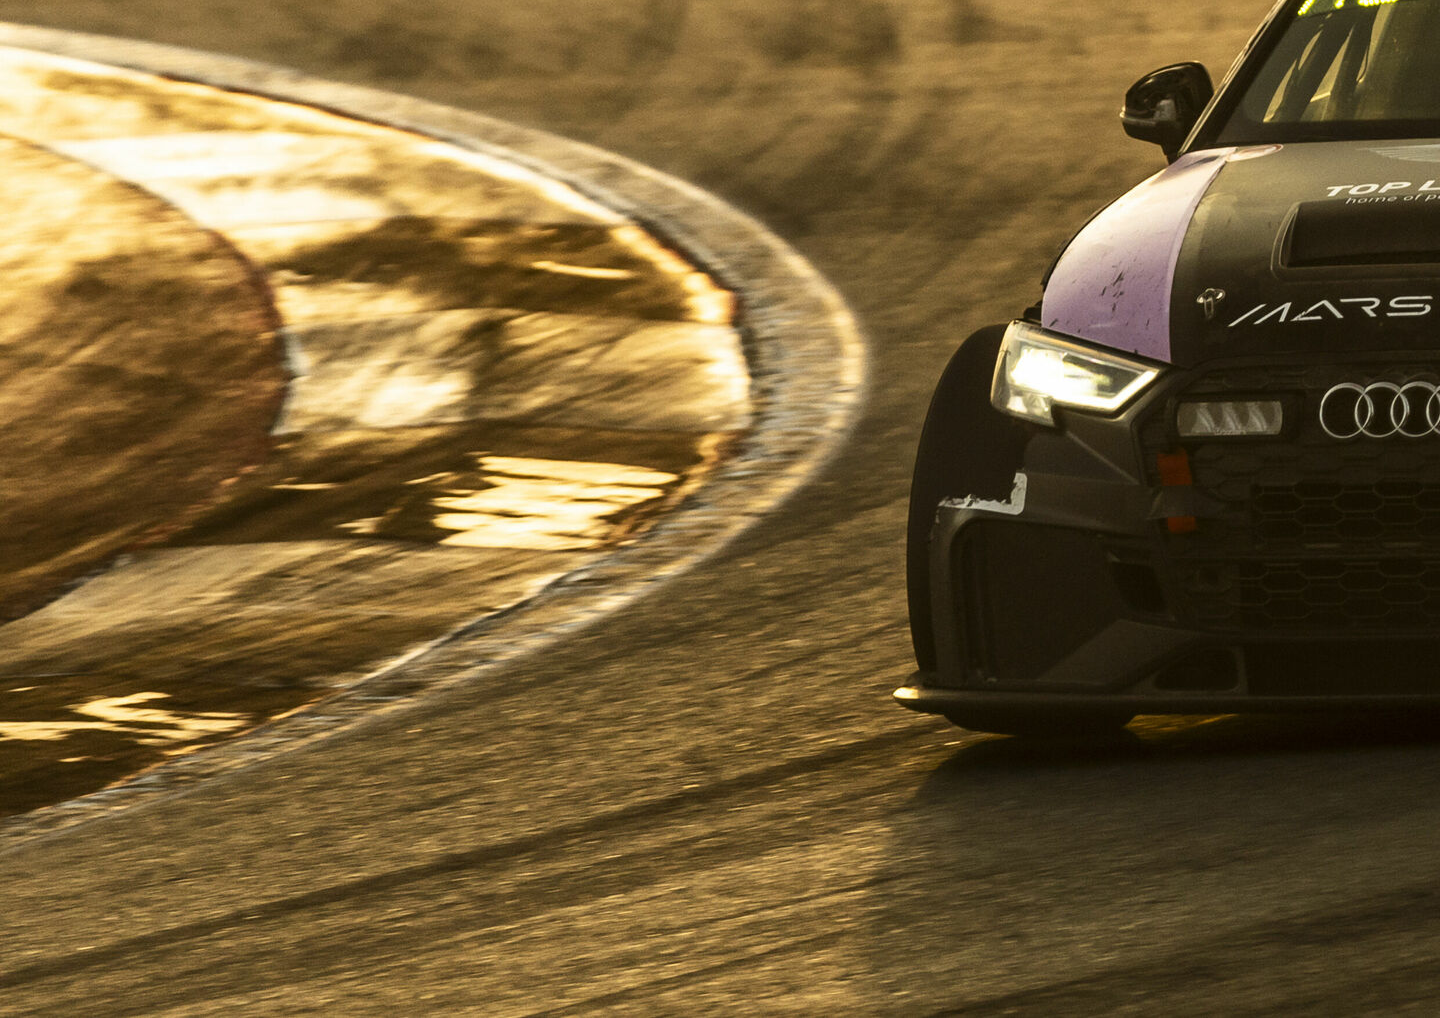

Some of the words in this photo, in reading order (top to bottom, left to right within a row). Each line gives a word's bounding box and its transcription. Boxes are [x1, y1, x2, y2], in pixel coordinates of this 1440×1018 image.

[1326, 181, 1412, 198] TOP
[1345, 195, 1397, 205] home
[1403, 192, 1422, 202] of
[1228, 295, 1433, 328] MARS
